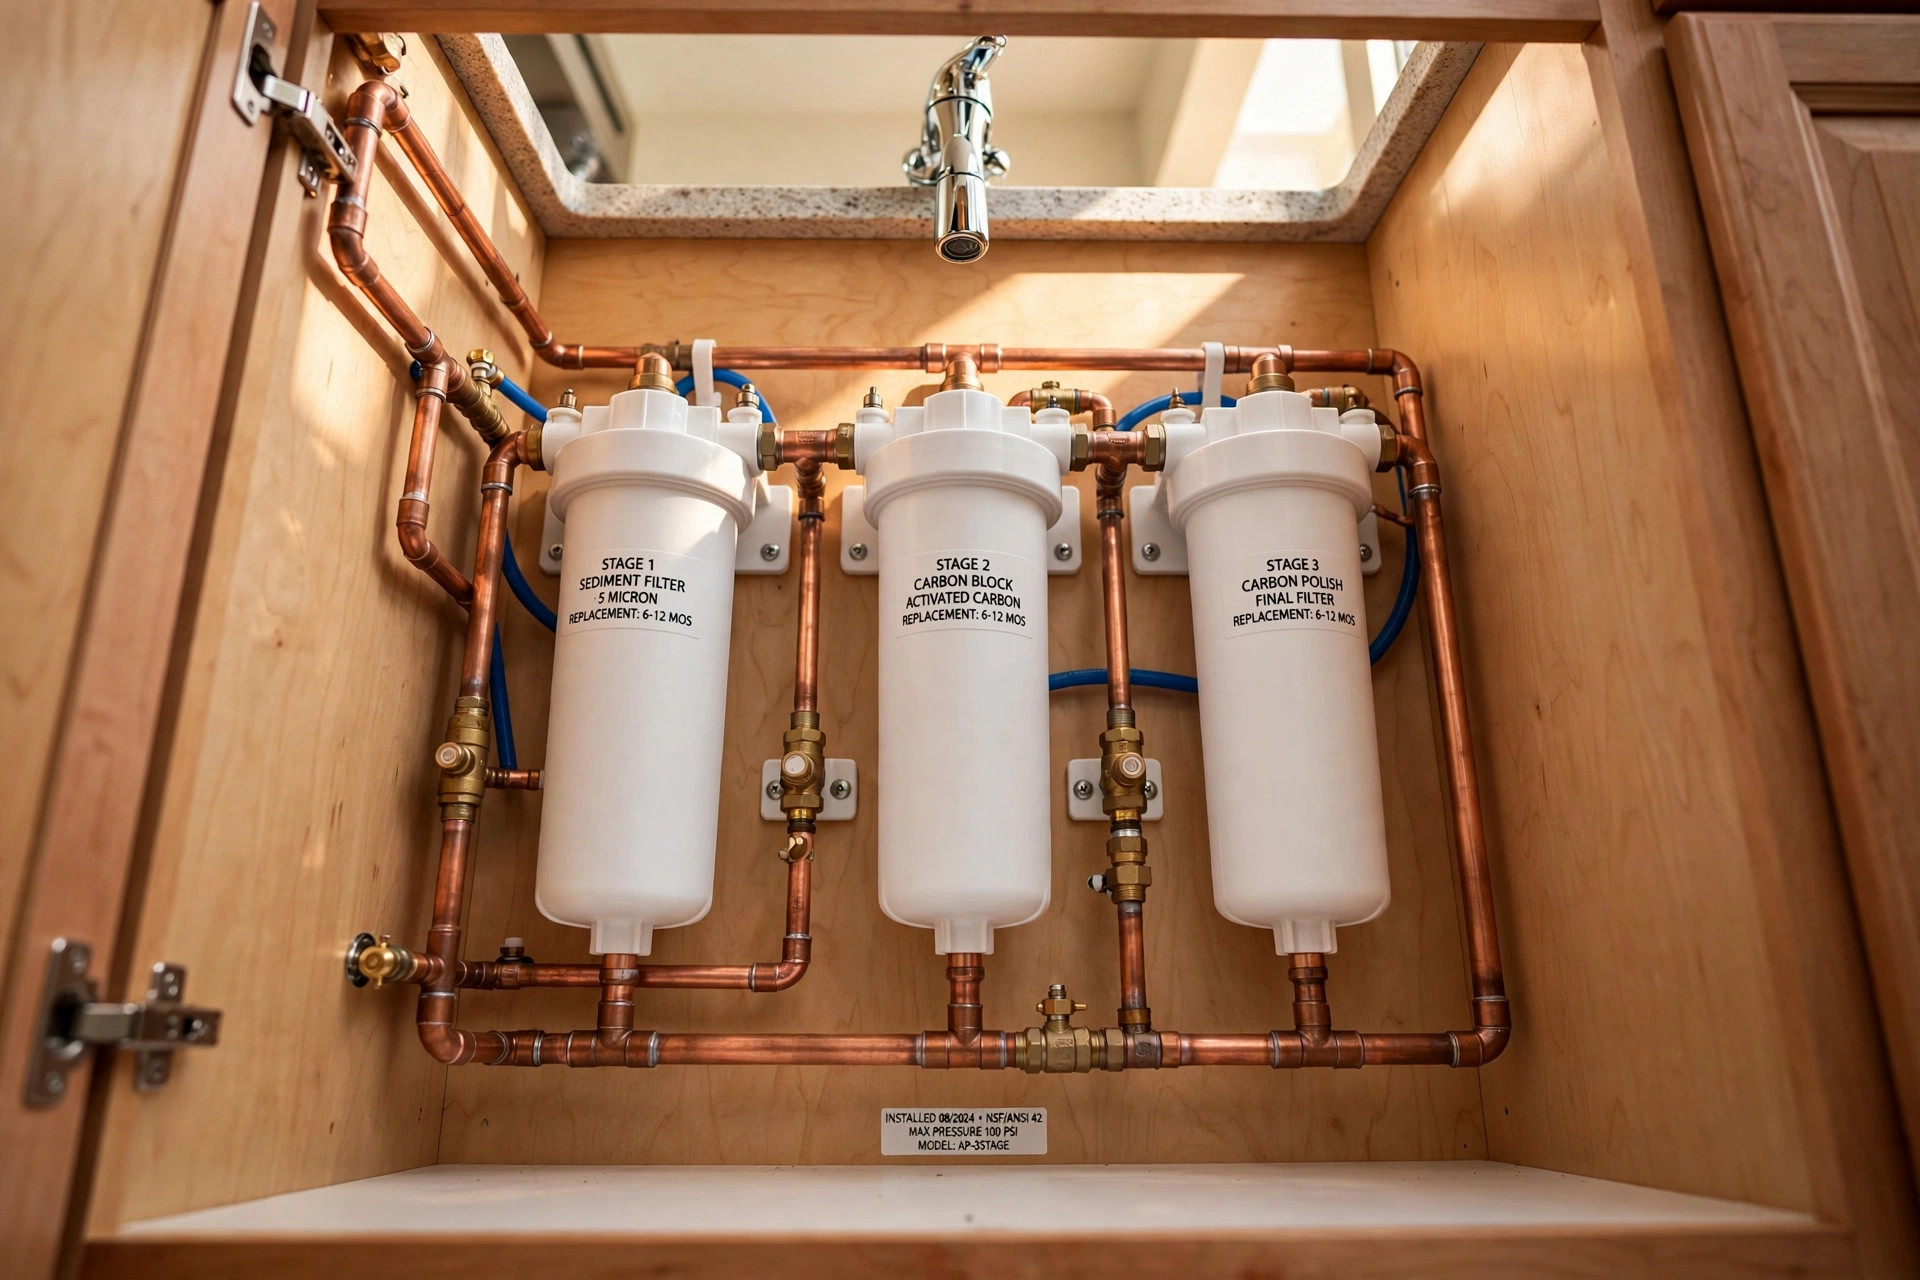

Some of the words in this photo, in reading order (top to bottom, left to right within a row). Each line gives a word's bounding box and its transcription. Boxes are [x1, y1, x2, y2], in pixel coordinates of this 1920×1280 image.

[602, 557, 644, 570] STAGE
[648, 559, 654, 571] 1
[936, 557, 978, 571] STAGE
[982, 559, 990, 571] 2
[1266, 558, 1309, 572] STAGE
[1312, 559, 1319, 571] 3
[579, 574, 641, 591] SEDIMENT
[644, 575, 686, 593] FILTER
[914, 574, 967, 590] CARBON
[971, 575, 1013, 592] BLOCK
[1241, 575, 1298, 592] CARBON
[1301, 575, 1343, 591] POLISH
[598, 592, 605, 604] 5
[608, 591, 658, 604] MICRON
[906, 591, 970, 609] ACTIVATED
[973, 591, 1021, 609] CARBON
[1255, 592, 1294, 607] FINAL
[1296, 592, 1335, 606] FILTER
[568, 608, 640, 624] REPLACEMENT:
[642, 609, 666, 622] 6-12
[668, 612, 692, 626] MOS
[902, 608, 979, 626] REPLACEMENT:
[981, 609, 1003, 622] 6-12
[1005, 612, 1026, 626] MOS
[1233, 608, 1313, 627] REPLACEMENT:
[1315, 609, 1336, 622] 6-12
[1338, 612, 1356, 626] MOS
[885, 1113, 936, 1123] INSTALLED
[938, 1113, 975, 1124] 08/2024
[986, 1113, 1029, 1124] NSF/ANSI
[1031, 1113, 1042, 1123] 42
[909, 1127, 930, 1137] MAX
[932, 1126, 982, 1137] PRESSURE
[985, 1126, 1000, 1137] 100
[1004, 1126, 1018, 1137] PSI
[918, 1140, 955, 1150] MODEL:
[958, 1140, 1009, 1150] AP-3STAGE
